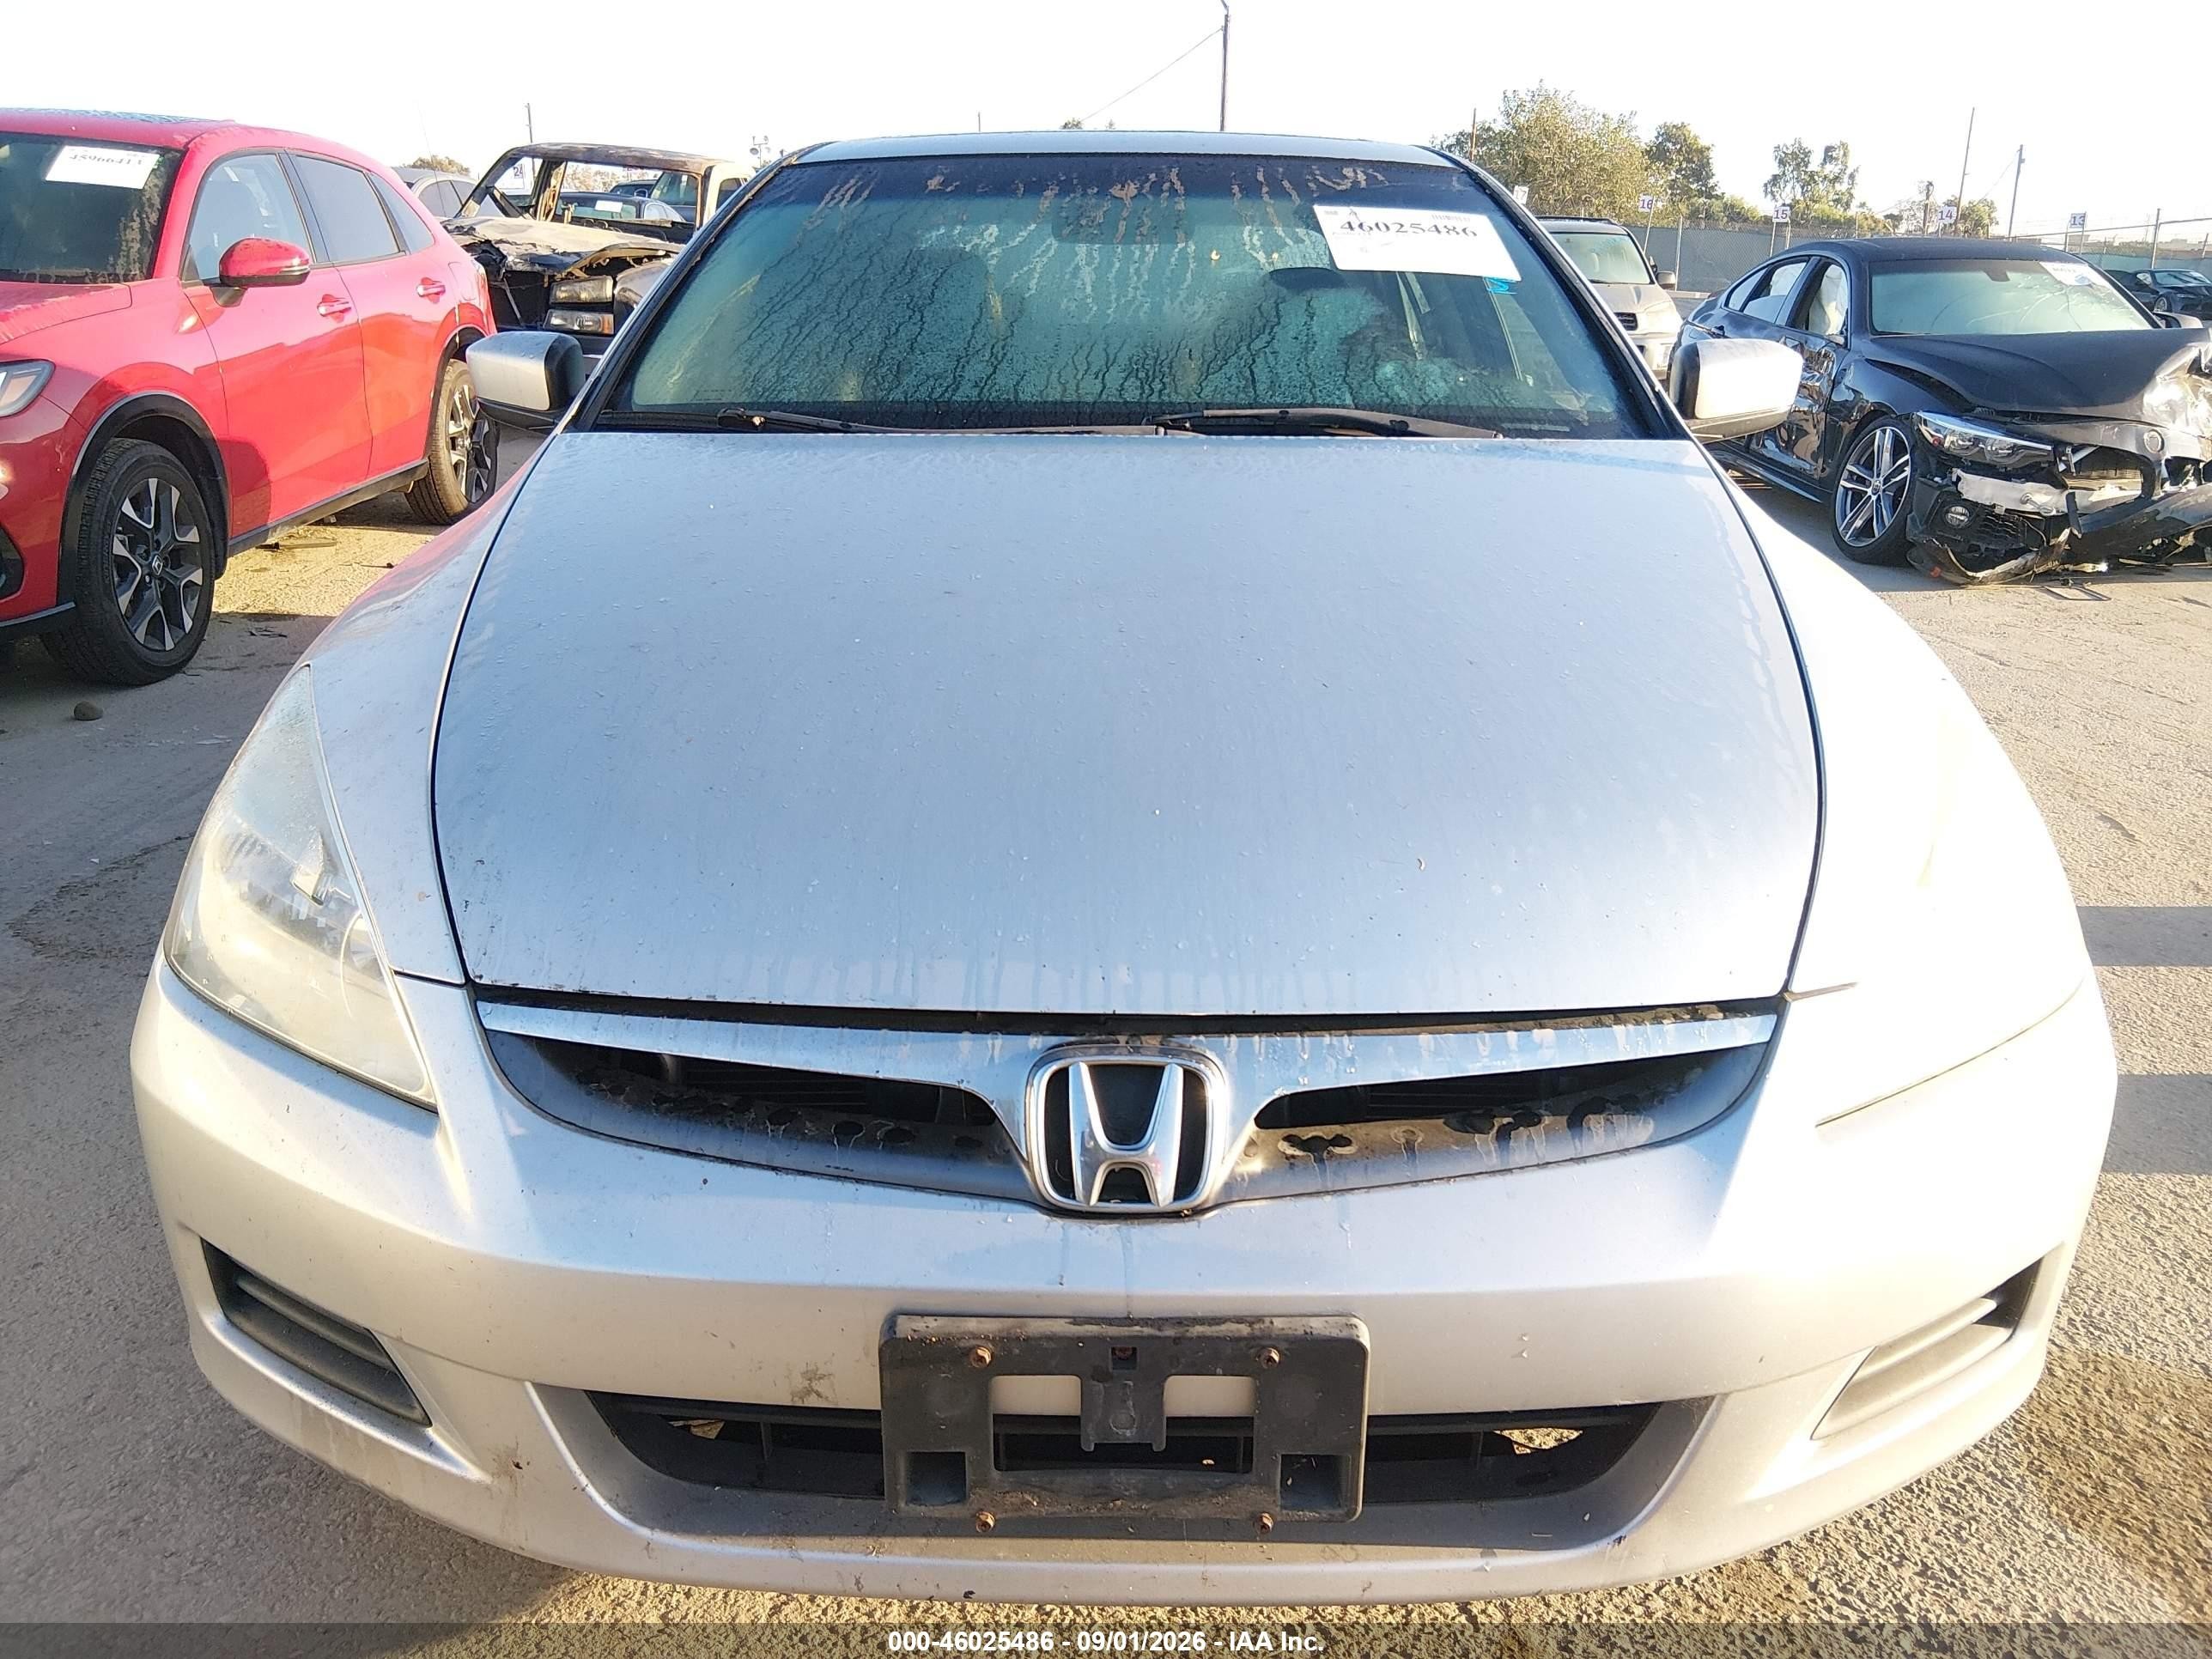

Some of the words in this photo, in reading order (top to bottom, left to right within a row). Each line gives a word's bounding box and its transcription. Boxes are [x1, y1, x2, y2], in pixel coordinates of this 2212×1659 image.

[1639, 198, 1654, 210] 16
[1773, 209, 1788, 220] 15
[1938, 210, 1953, 221] 14
[2070, 216, 2085, 226] 13
[1340, 220, 1478, 238] 46025486
